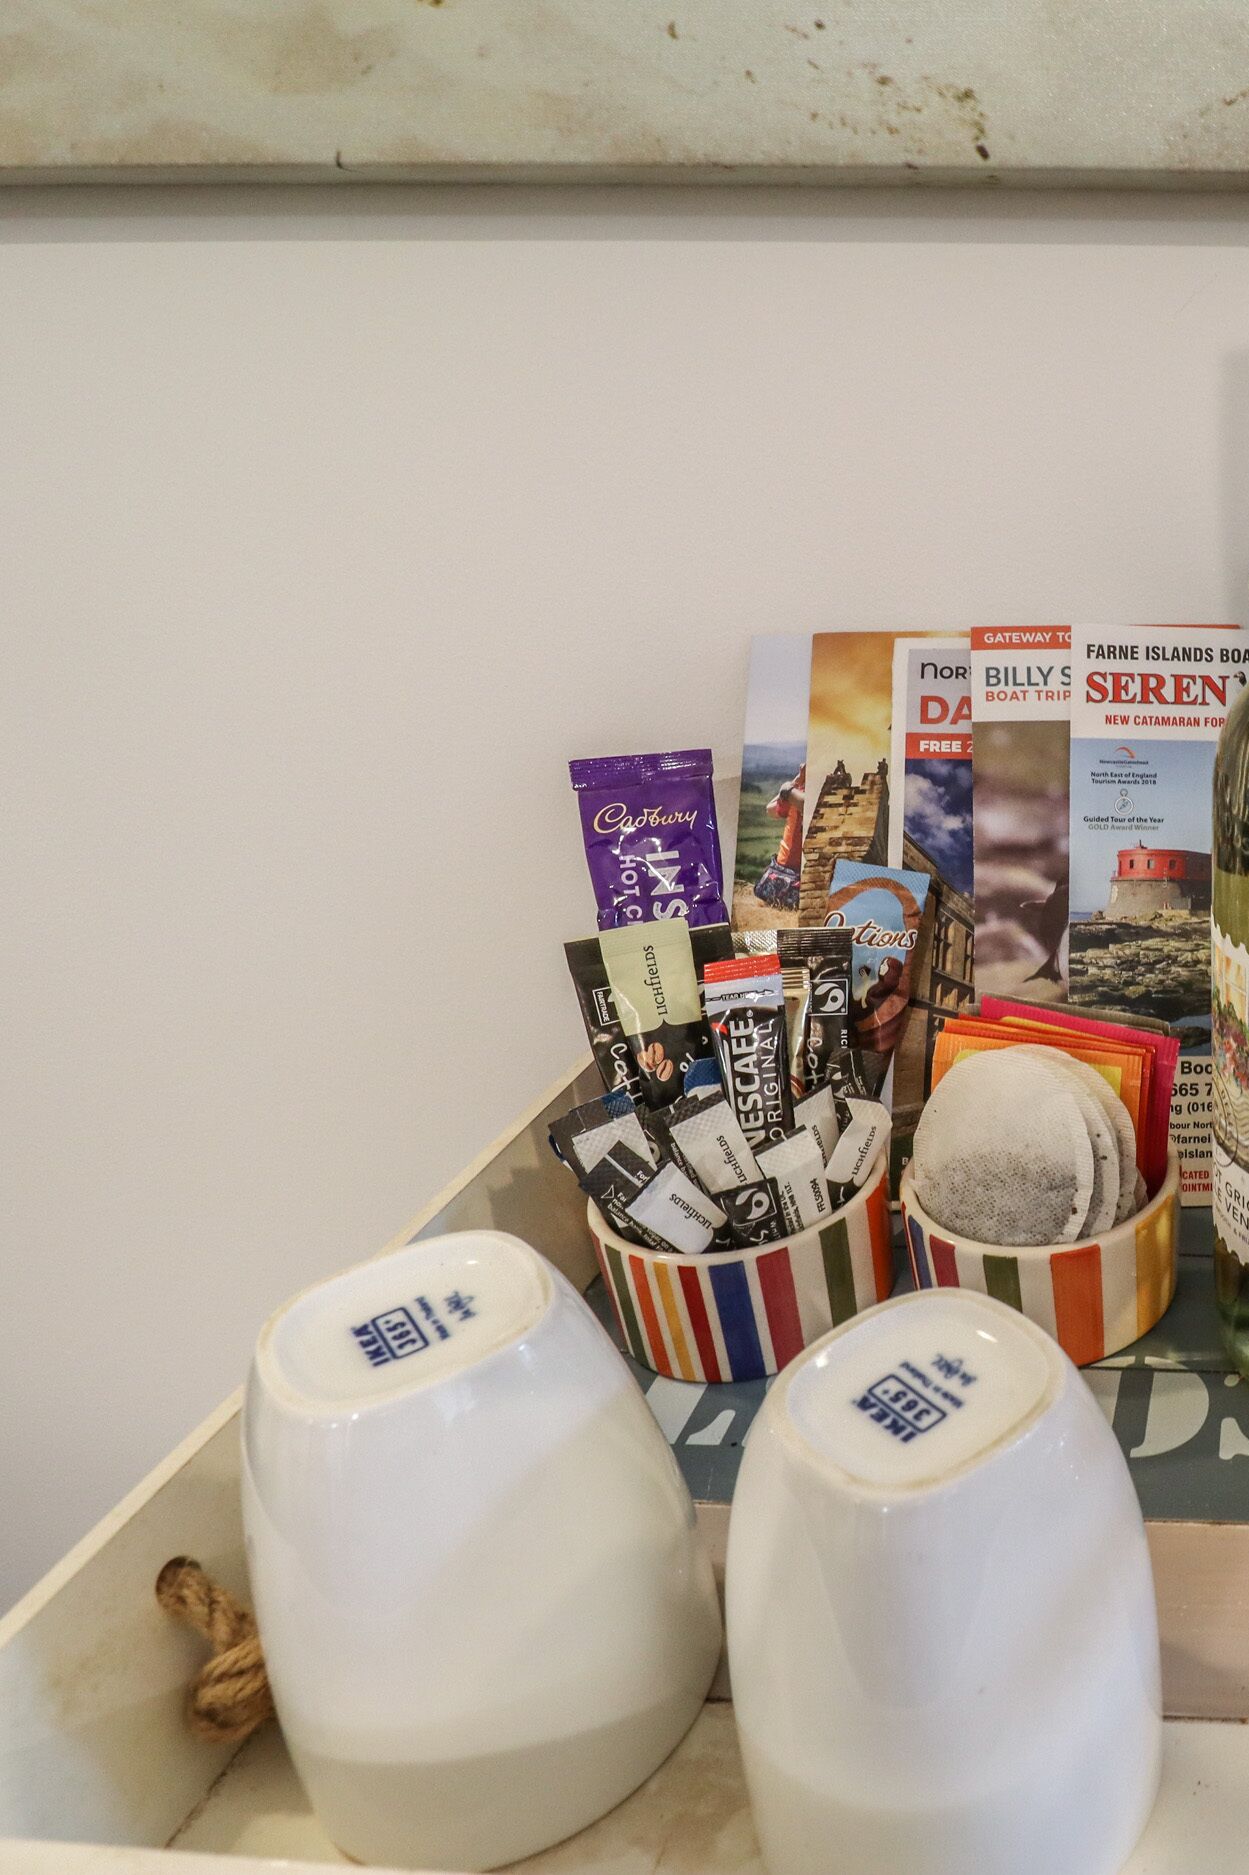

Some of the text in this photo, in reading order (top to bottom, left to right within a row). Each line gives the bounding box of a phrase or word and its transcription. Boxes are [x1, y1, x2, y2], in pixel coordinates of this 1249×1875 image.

[984, 632, 1051, 643] GATEWAY
[1086, 644, 1139, 661] FARNE
[1145, 646, 1214, 663] ISLANDS
[985, 666, 1054, 687] BILLY
[986, 690, 1028, 702] BOAT
[1086, 671, 1230, 707] SEREN
[1105, 714, 1130, 725] NEW
[1134, 715, 1200, 727] CATAMARAN
[919, 740, 962, 752] FREE
[1132, 772, 1157, 780] England
[593, 803, 698, 834] Cadbury
[1110, 823, 1133, 831] Award
[619, 854, 640, 897] HOT
[352, 1324, 391, 1367] IKEA
[857, 1395, 917, 1443] IKEA
